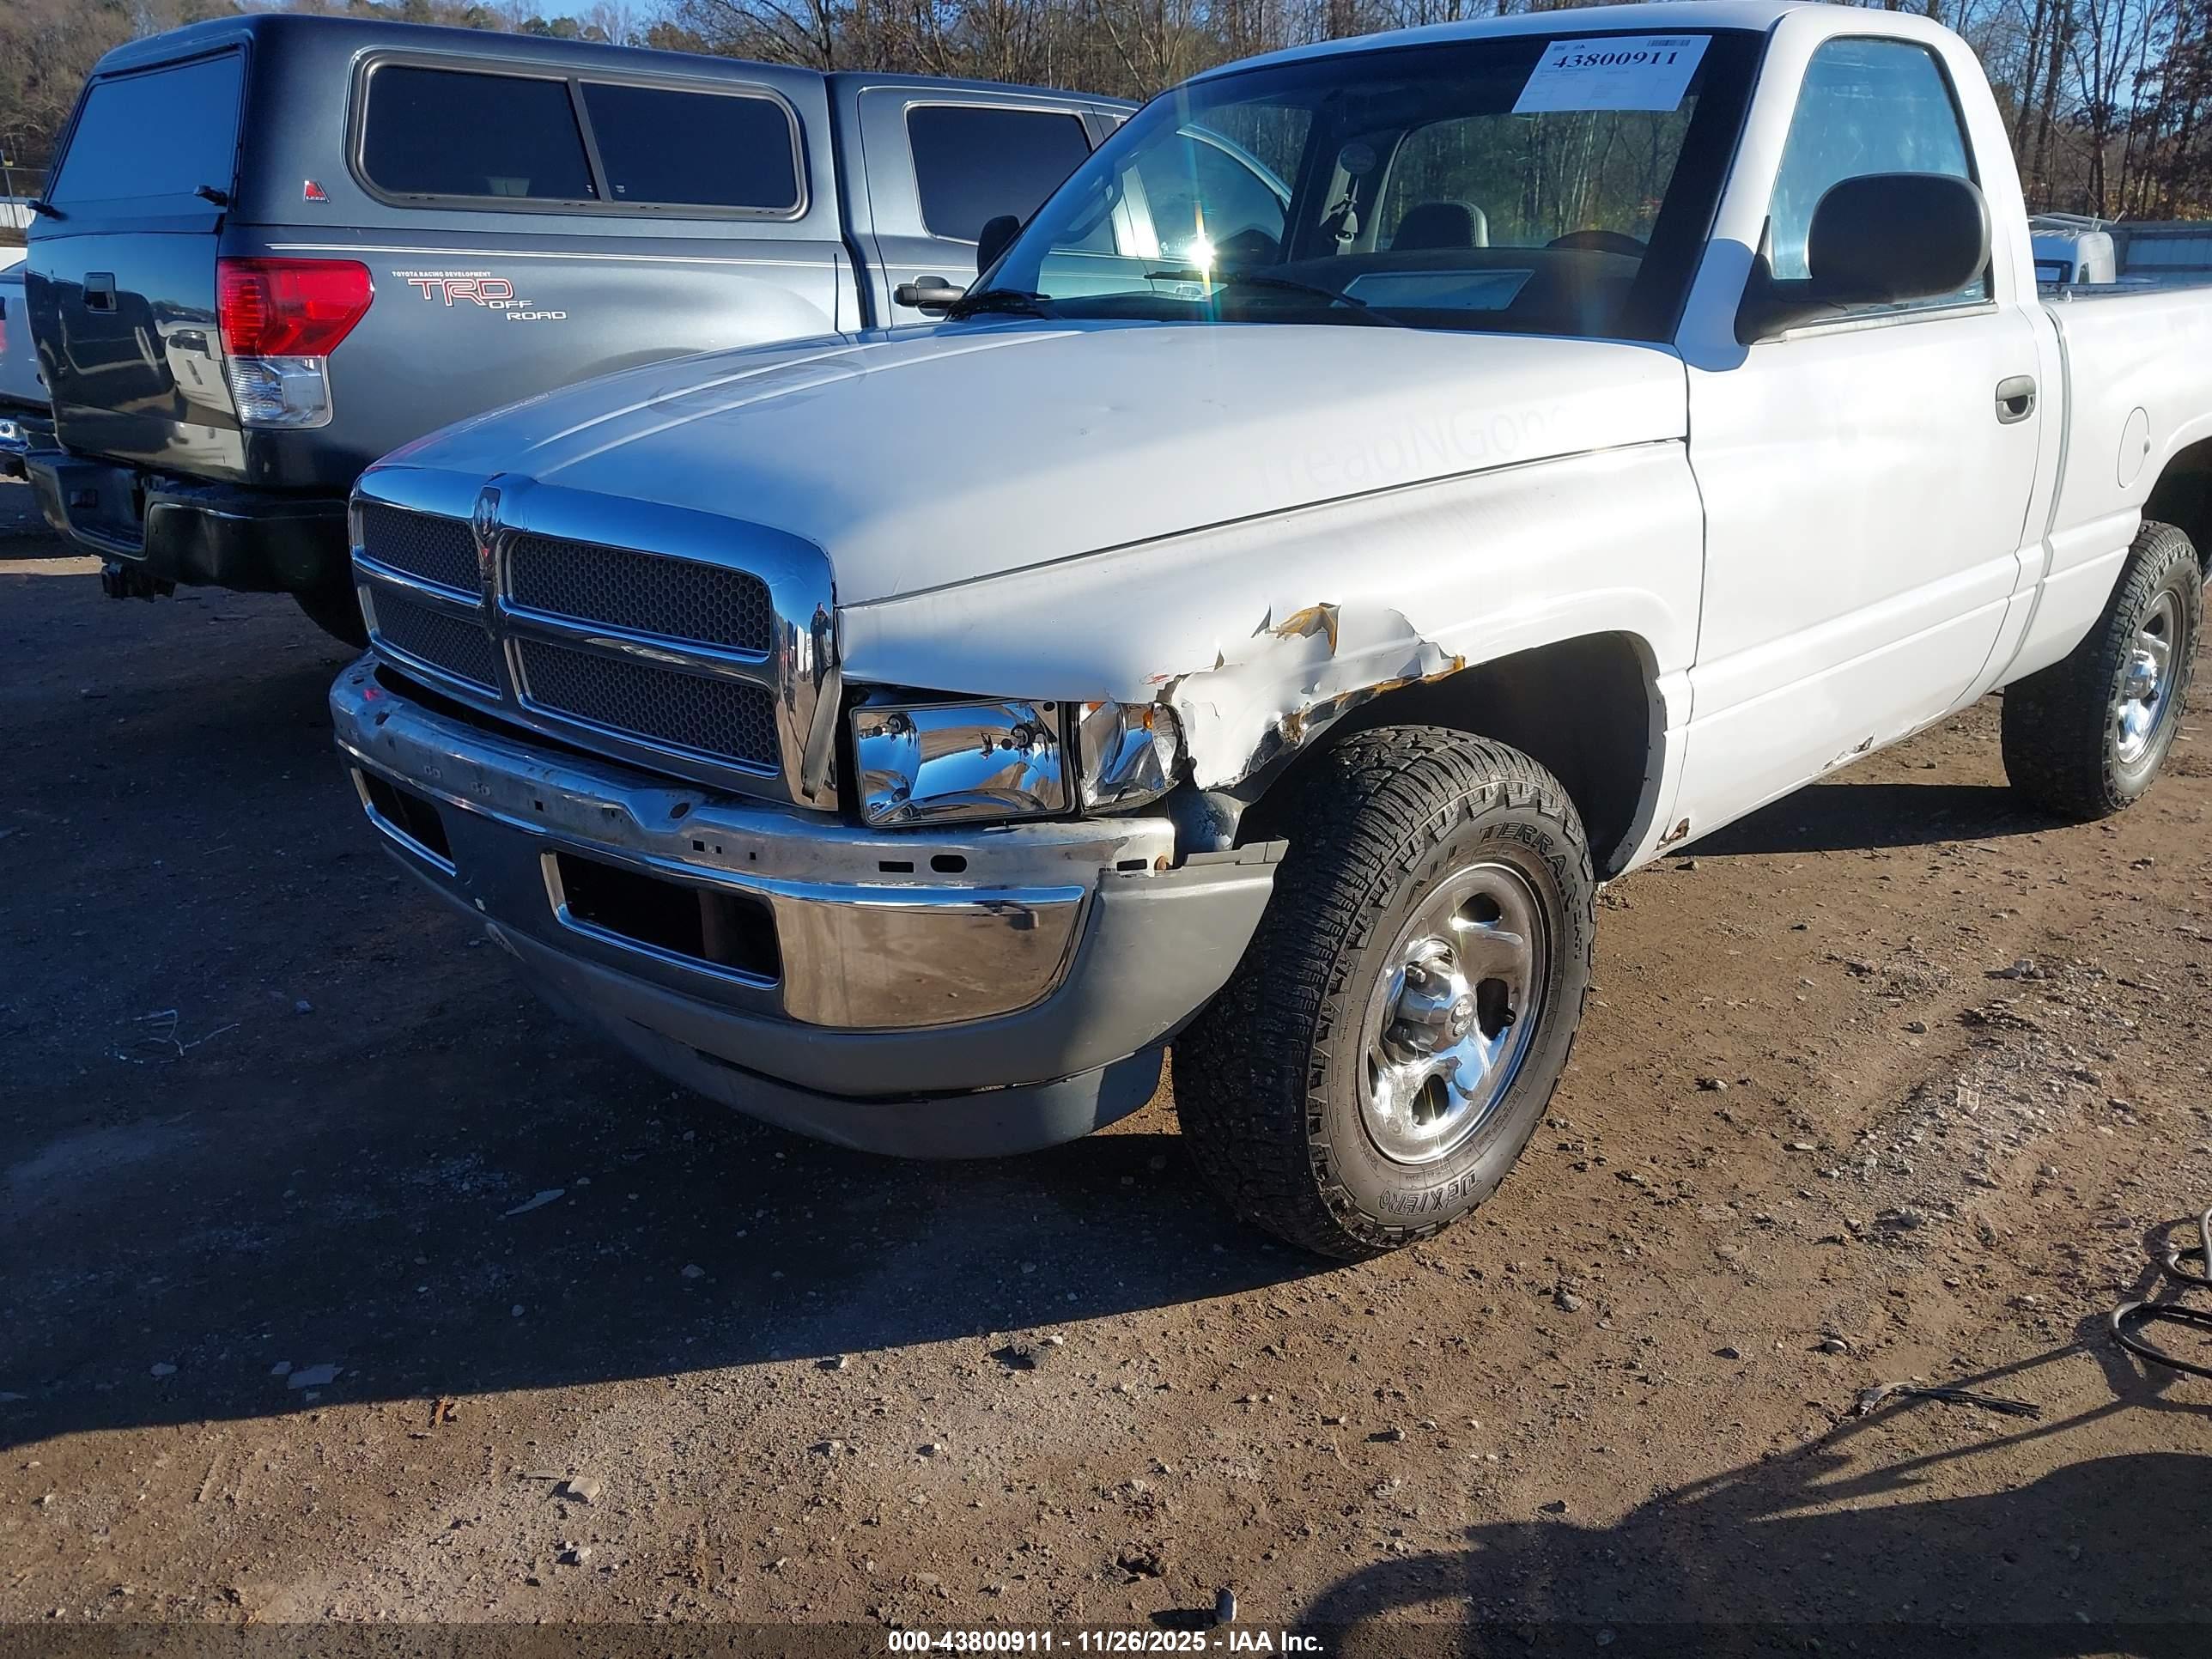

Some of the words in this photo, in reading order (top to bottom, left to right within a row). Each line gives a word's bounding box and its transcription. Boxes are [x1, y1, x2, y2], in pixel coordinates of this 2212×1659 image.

[1553, 52, 1678, 68] 43800911
[408, 278, 514, 306] TRD
[489, 301, 533, 309] OFF
[507, 311, 567, 320] ROAD
[1379, 1170, 1483, 1216] DEXTERO
